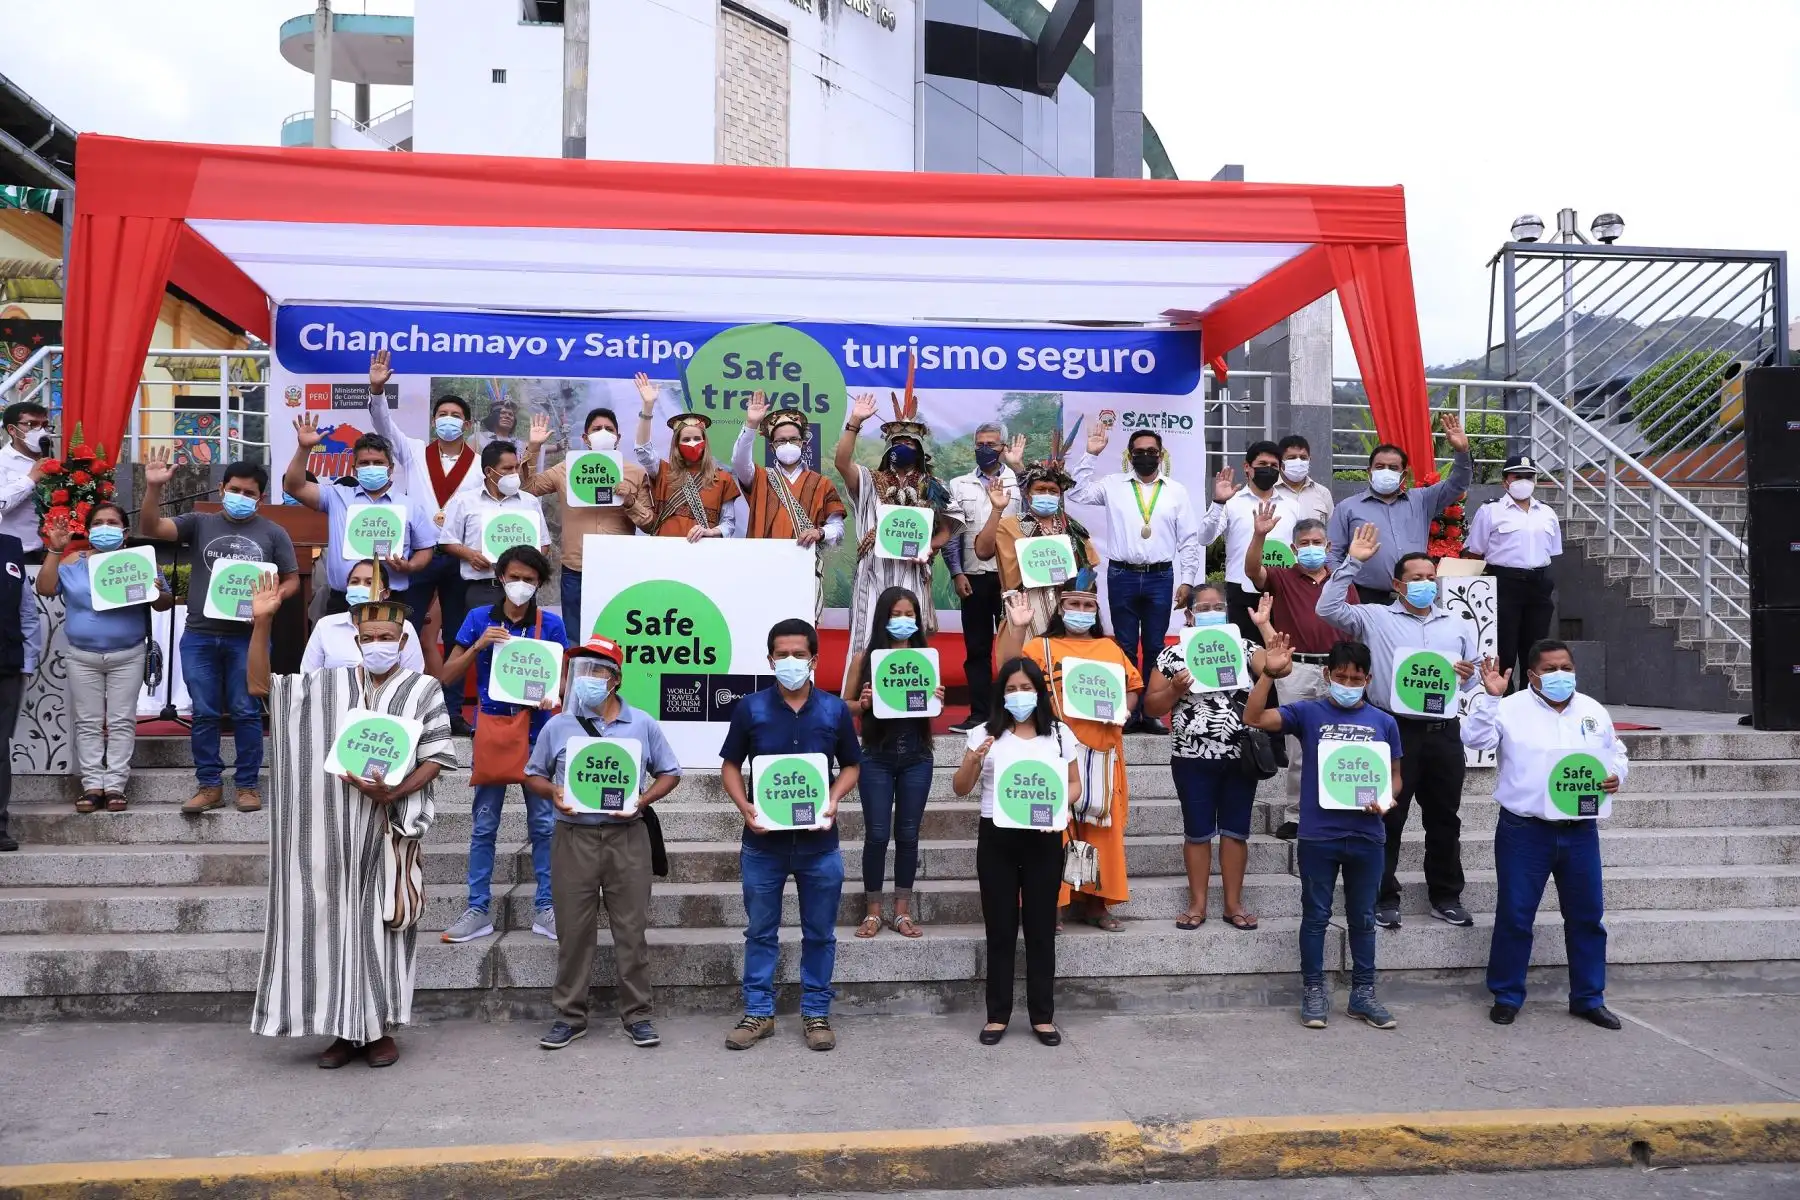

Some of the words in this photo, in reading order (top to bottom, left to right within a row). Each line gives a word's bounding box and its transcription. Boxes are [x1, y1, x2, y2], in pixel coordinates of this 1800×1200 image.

[299, 322, 548, 360] Chanchamayo
[555, 337, 577, 361] y
[583, 332, 694, 364] Satipo
[842, 335, 1007, 370] turismo
[1016, 346, 1156, 380] seguro
[722, 351, 803, 382] Safe
[309, 392, 329, 401] PERÚ
[701, 382, 830, 414] travels
[1121, 410, 1194, 430] SATIPO
[581, 463, 607, 475] Safe
[575, 473, 616, 485] travels
[361, 516, 388, 528] Safe
[497, 523, 523, 534] Safe
[892, 518, 917, 529] Safe
[354, 526, 396, 538] travels
[490, 532, 532, 544] travels
[885, 527, 924, 540] travels
[207, 550, 263, 561] BILLABONG
[1032, 547, 1057, 559] Safe
[1262, 550, 1283, 561] afe
[107, 561, 137, 575] Safe
[1027, 556, 1068, 568] travels
[101, 570, 148, 587] travels
[218, 584, 253, 597] trave
[625, 608, 694, 637] Safe
[615, 637, 717, 666] ravels
[1198, 640, 1225, 654] Safe
[511, 651, 542, 666] Safe
[1193, 651, 1237, 667] travels
[502, 662, 551, 680] travels
[889, 661, 919, 675] Safe
[1411, 663, 1441, 678] Safe
[882, 674, 930, 688] travels
[1078, 673, 1106, 687] Safe
[1402, 675, 1450, 691] travels
[667, 687, 695, 695] WORLD
[1071, 684, 1116, 700] travels
[360, 727, 394, 746] Safe
[347, 737, 401, 761] travels
[586, 755, 620, 770] Safe
[1337, 757, 1370, 770] Safe
[576, 769, 630, 785] travels
[773, 770, 806, 787] Safe
[1329, 770, 1381, 783] travels
[1563, 765, 1593, 779] Safe
[1013, 773, 1046, 787] Safe
[1555, 777, 1602, 792] travels
[765, 784, 818, 800] travels
[1005, 786, 1057, 801] travels
